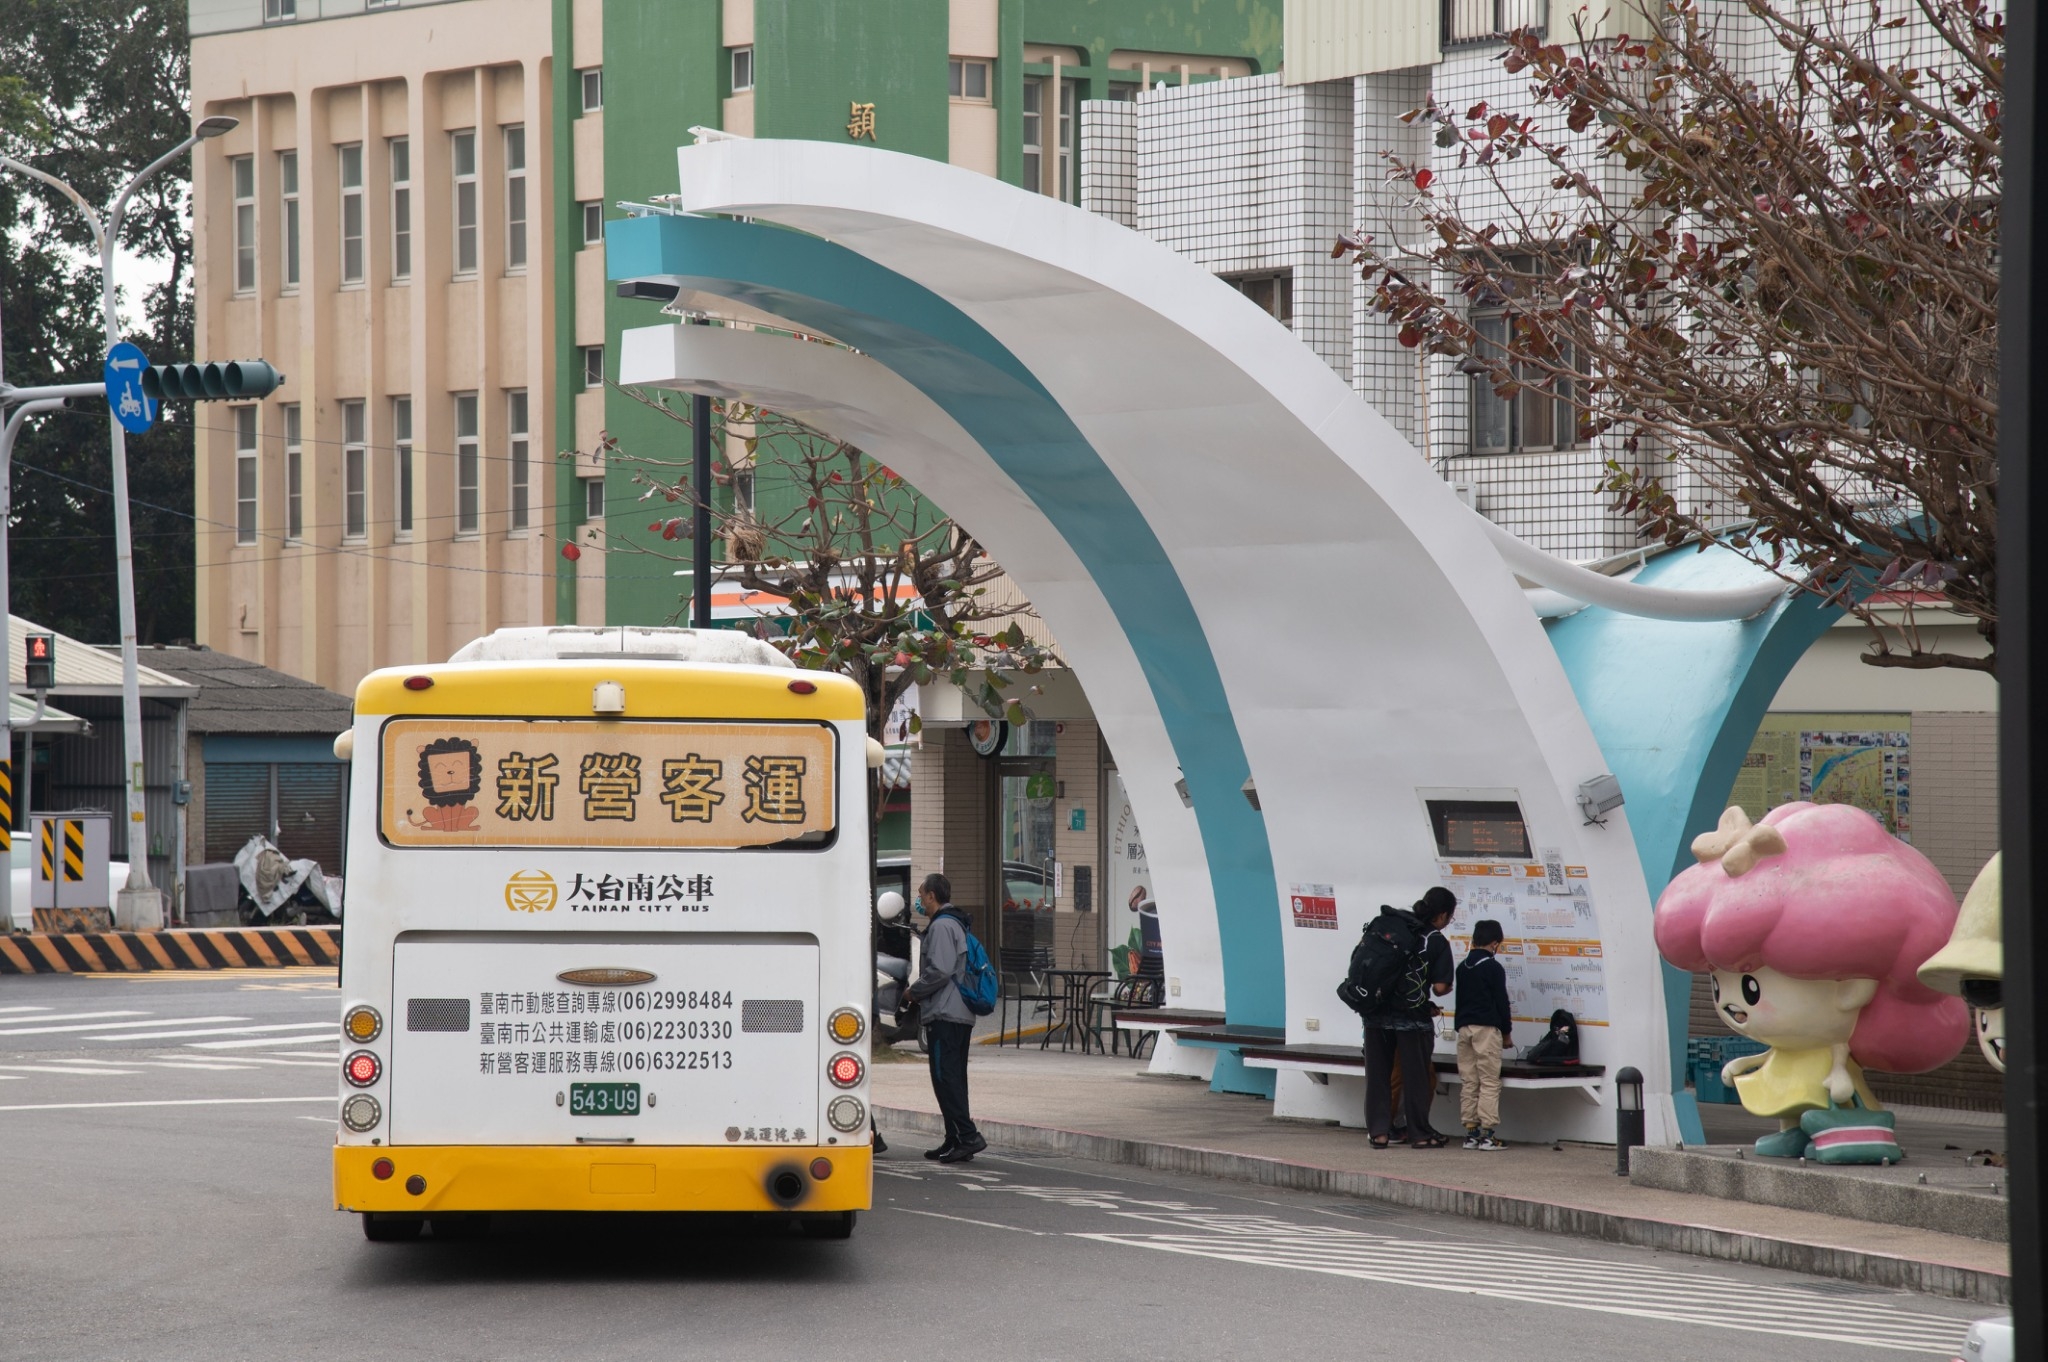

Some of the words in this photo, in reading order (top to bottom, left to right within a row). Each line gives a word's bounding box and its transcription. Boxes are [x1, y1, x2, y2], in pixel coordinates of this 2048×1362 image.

[496, 752, 807, 824] 新營客運
[566, 873, 715, 902] 大台南公車
[571, 904, 631, 914] TAINAN
[639, 904, 673, 914] CITY
[682, 904, 710, 913] BUS
[480, 990, 733, 1015] 臺南市動態查詢專線(06)2998484
[480, 1020, 733, 1045] 臺南市公共運輸處(06)2230330
[480, 1050, 733, 1075] 新營客運服務專線(06)6322513
[572, 1089, 639, 1111] 543-U9
